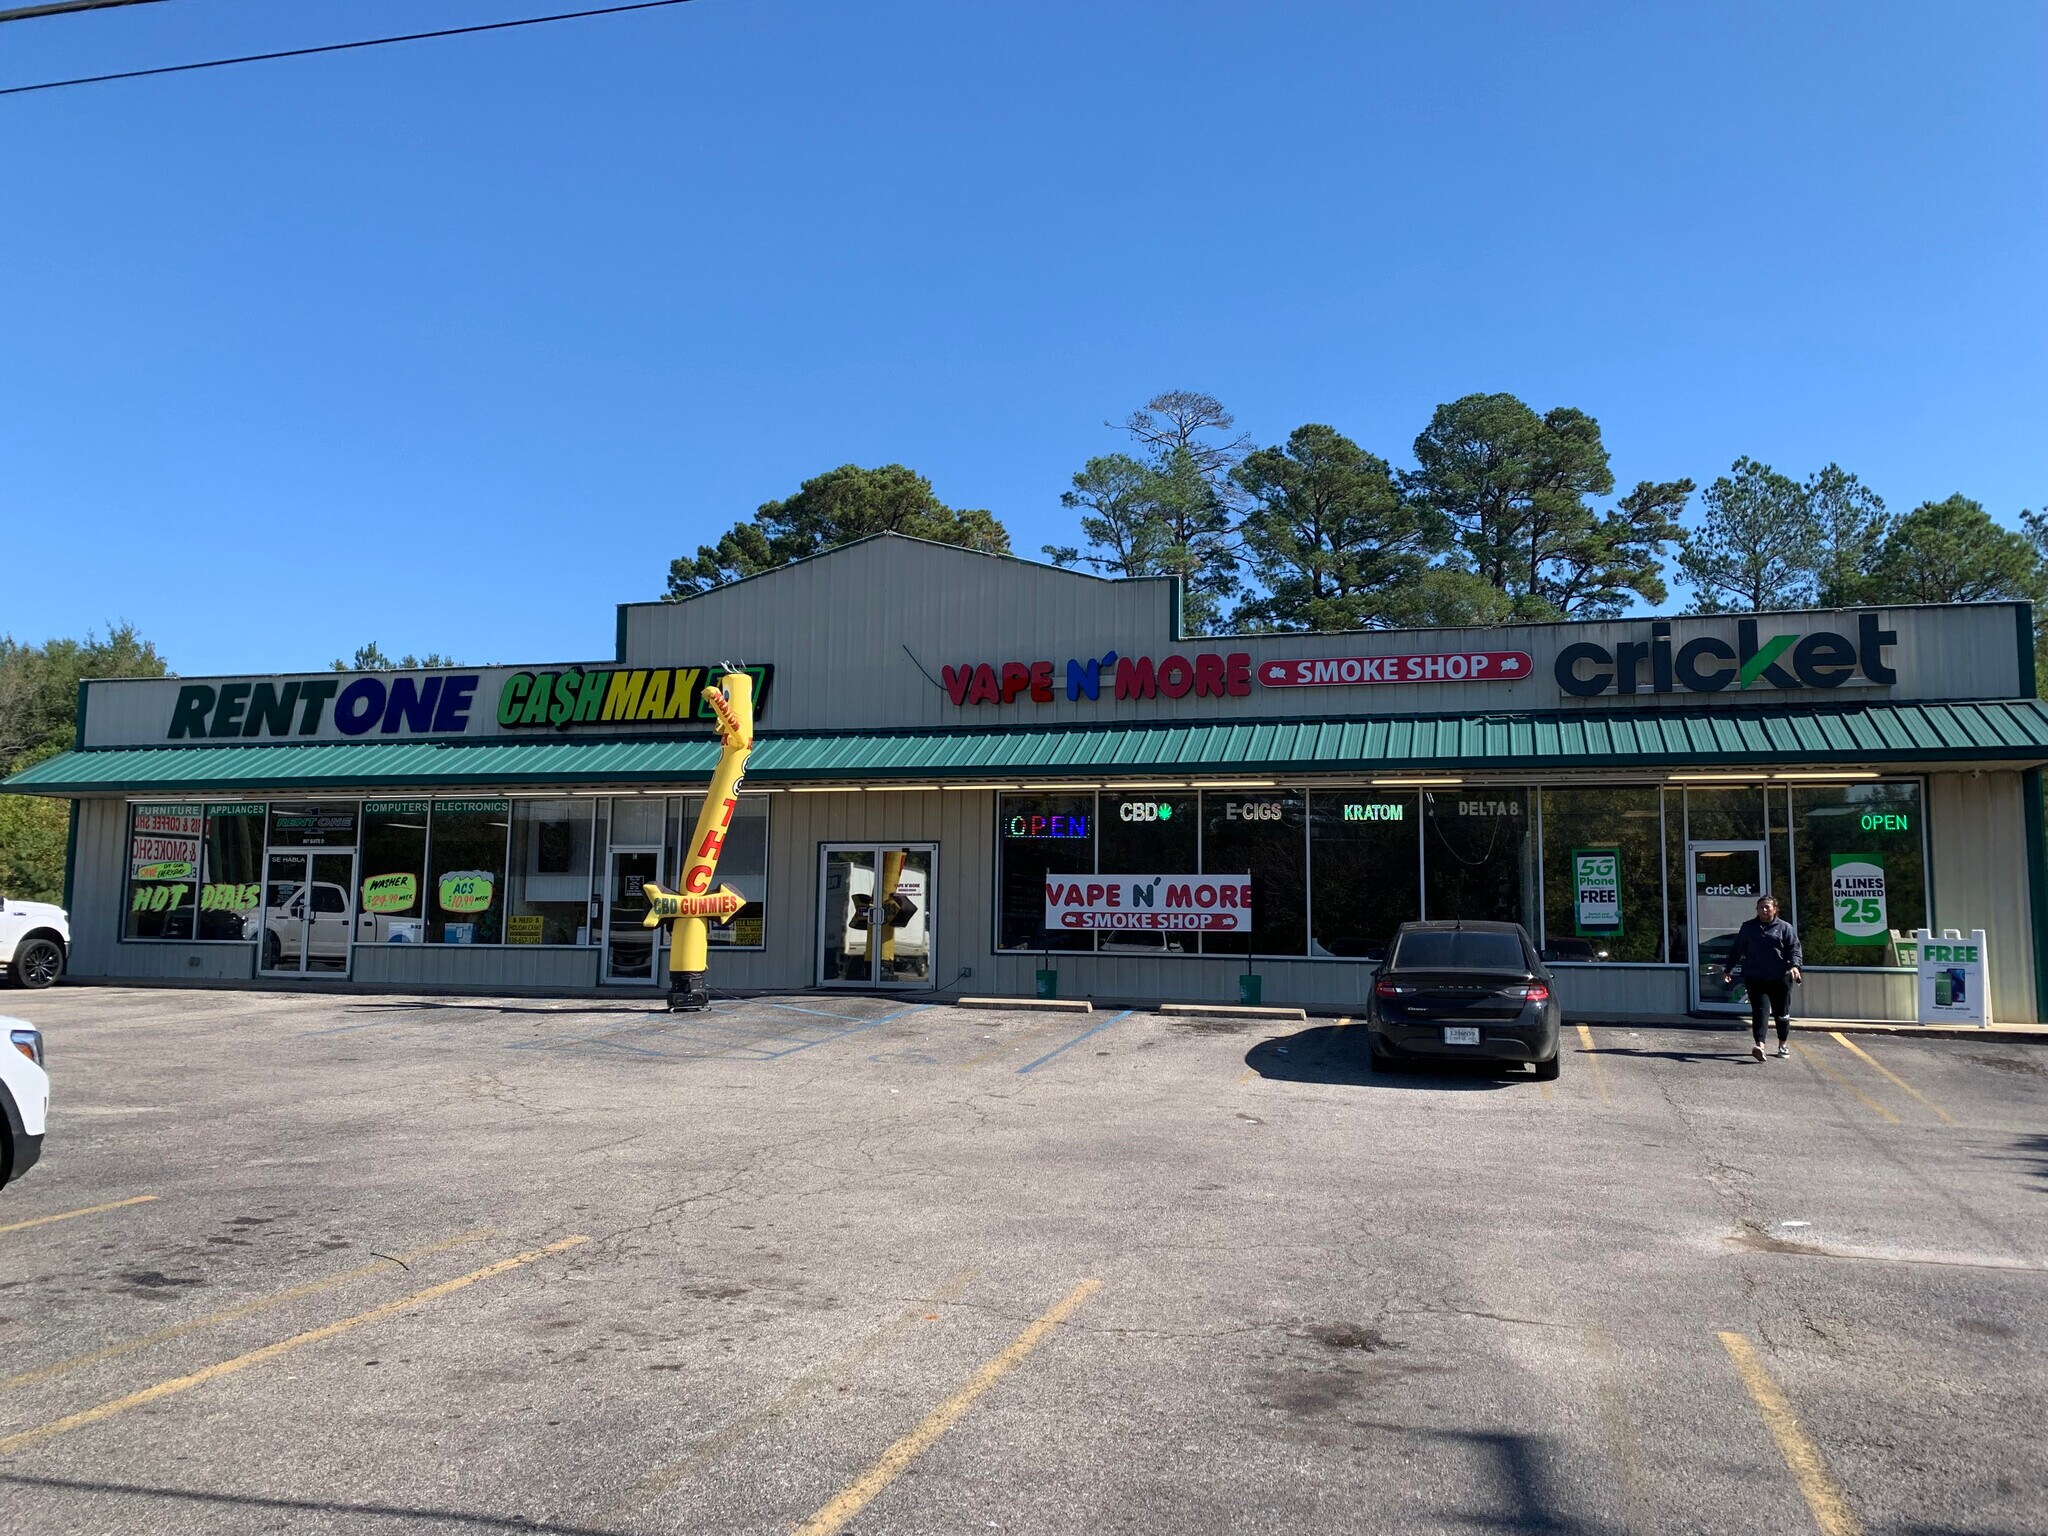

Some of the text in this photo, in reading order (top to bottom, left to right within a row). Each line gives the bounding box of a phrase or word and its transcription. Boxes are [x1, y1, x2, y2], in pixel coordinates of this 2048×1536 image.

[1554, 614, 1897, 696] cricket
[1297, 655, 1489, 684] SMOKE SHOP
[941, 661, 1055, 706] VAPE
[1114, 653, 1252, 699] MORE
[138, 806, 200, 816] FURNITURE
[210, 805, 264, 815] APPLIANCES
[365, 803, 429, 812] COMPUTERS
[434, 802, 509, 812] ELECTRONICS
[1119, 802, 1159, 822] CBD
[1225, 802, 1282, 821] E-CIGS
[1343, 804, 1403, 821] KRATOM
[1458, 801, 1519, 816] DELTA 8
[276, 817, 352, 828] RENT ONE
[1010, 815, 1086, 836] OPEN
[1861, 814, 1908, 830] OPEN
[1579, 858, 1614, 877] 5G
[369, 876, 408, 891] WASHER
[453, 882, 475, 895] ACS
[1579, 876, 1615, 886] Phone
[1705, 883, 1752, 895] cricket
[1833, 878, 1884, 889] 4 LINES
[132, 883, 189, 912] HOT
[200, 882, 261, 912] DEALS
[1046, 883, 1121, 907] VAPE
[1165, 884, 1252, 908] MORE
[1580, 889, 1616, 904] FREE
[1834, 889, 1884, 897] UNLIMITED
[653, 896, 737, 915] CBD GUMMIES
[1082, 913, 1213, 929] SMOKE SHOP
[1924, 945, 1978, 962] FREE
